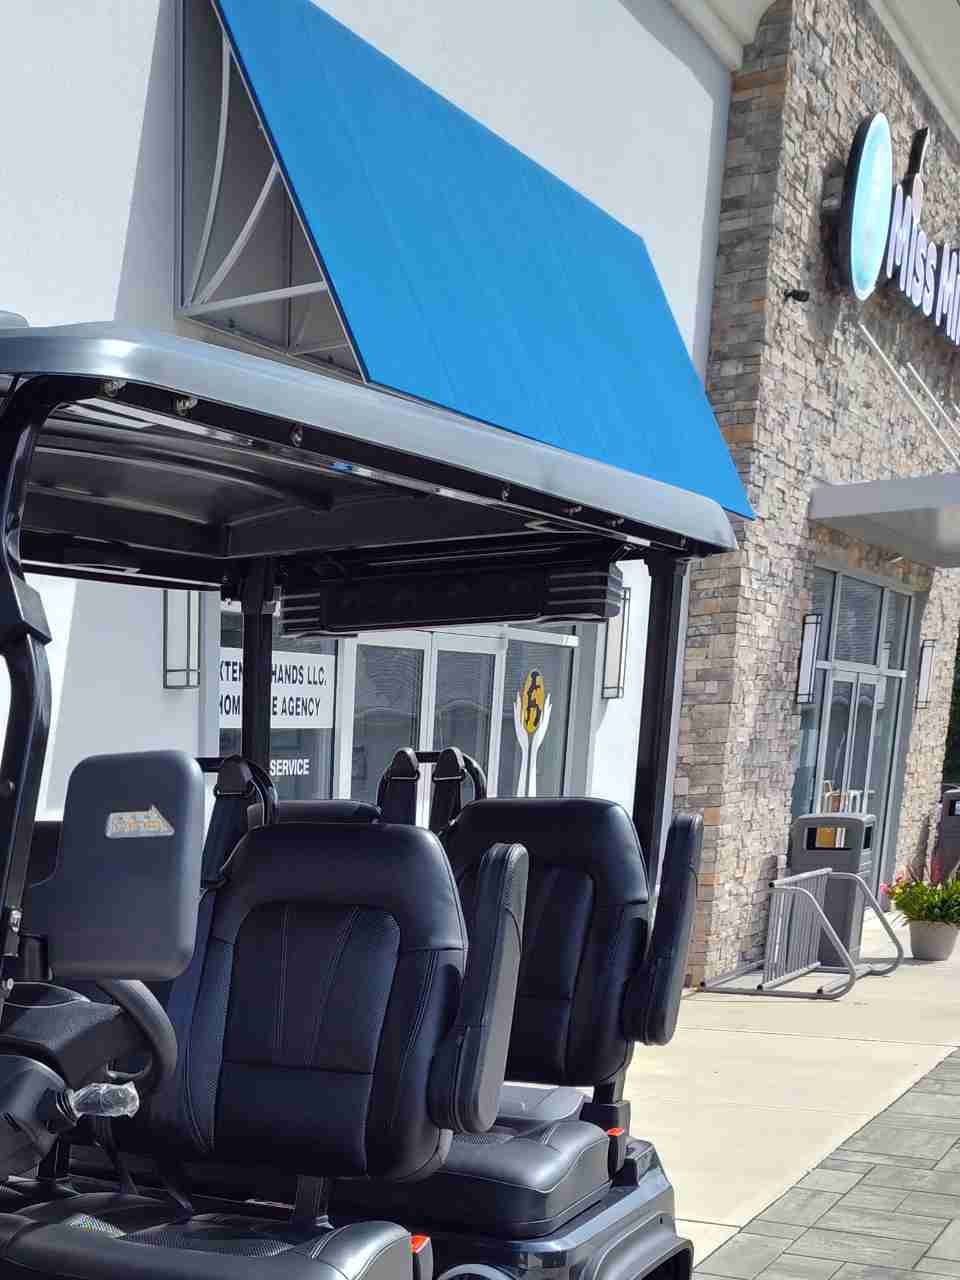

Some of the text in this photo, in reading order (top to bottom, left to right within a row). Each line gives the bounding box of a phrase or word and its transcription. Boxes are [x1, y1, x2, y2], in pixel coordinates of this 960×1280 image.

[271, 663, 304, 686] HANDS
[281, 696, 321, 717] AGENCY
[270, 759, 310, 776] SERVICE
